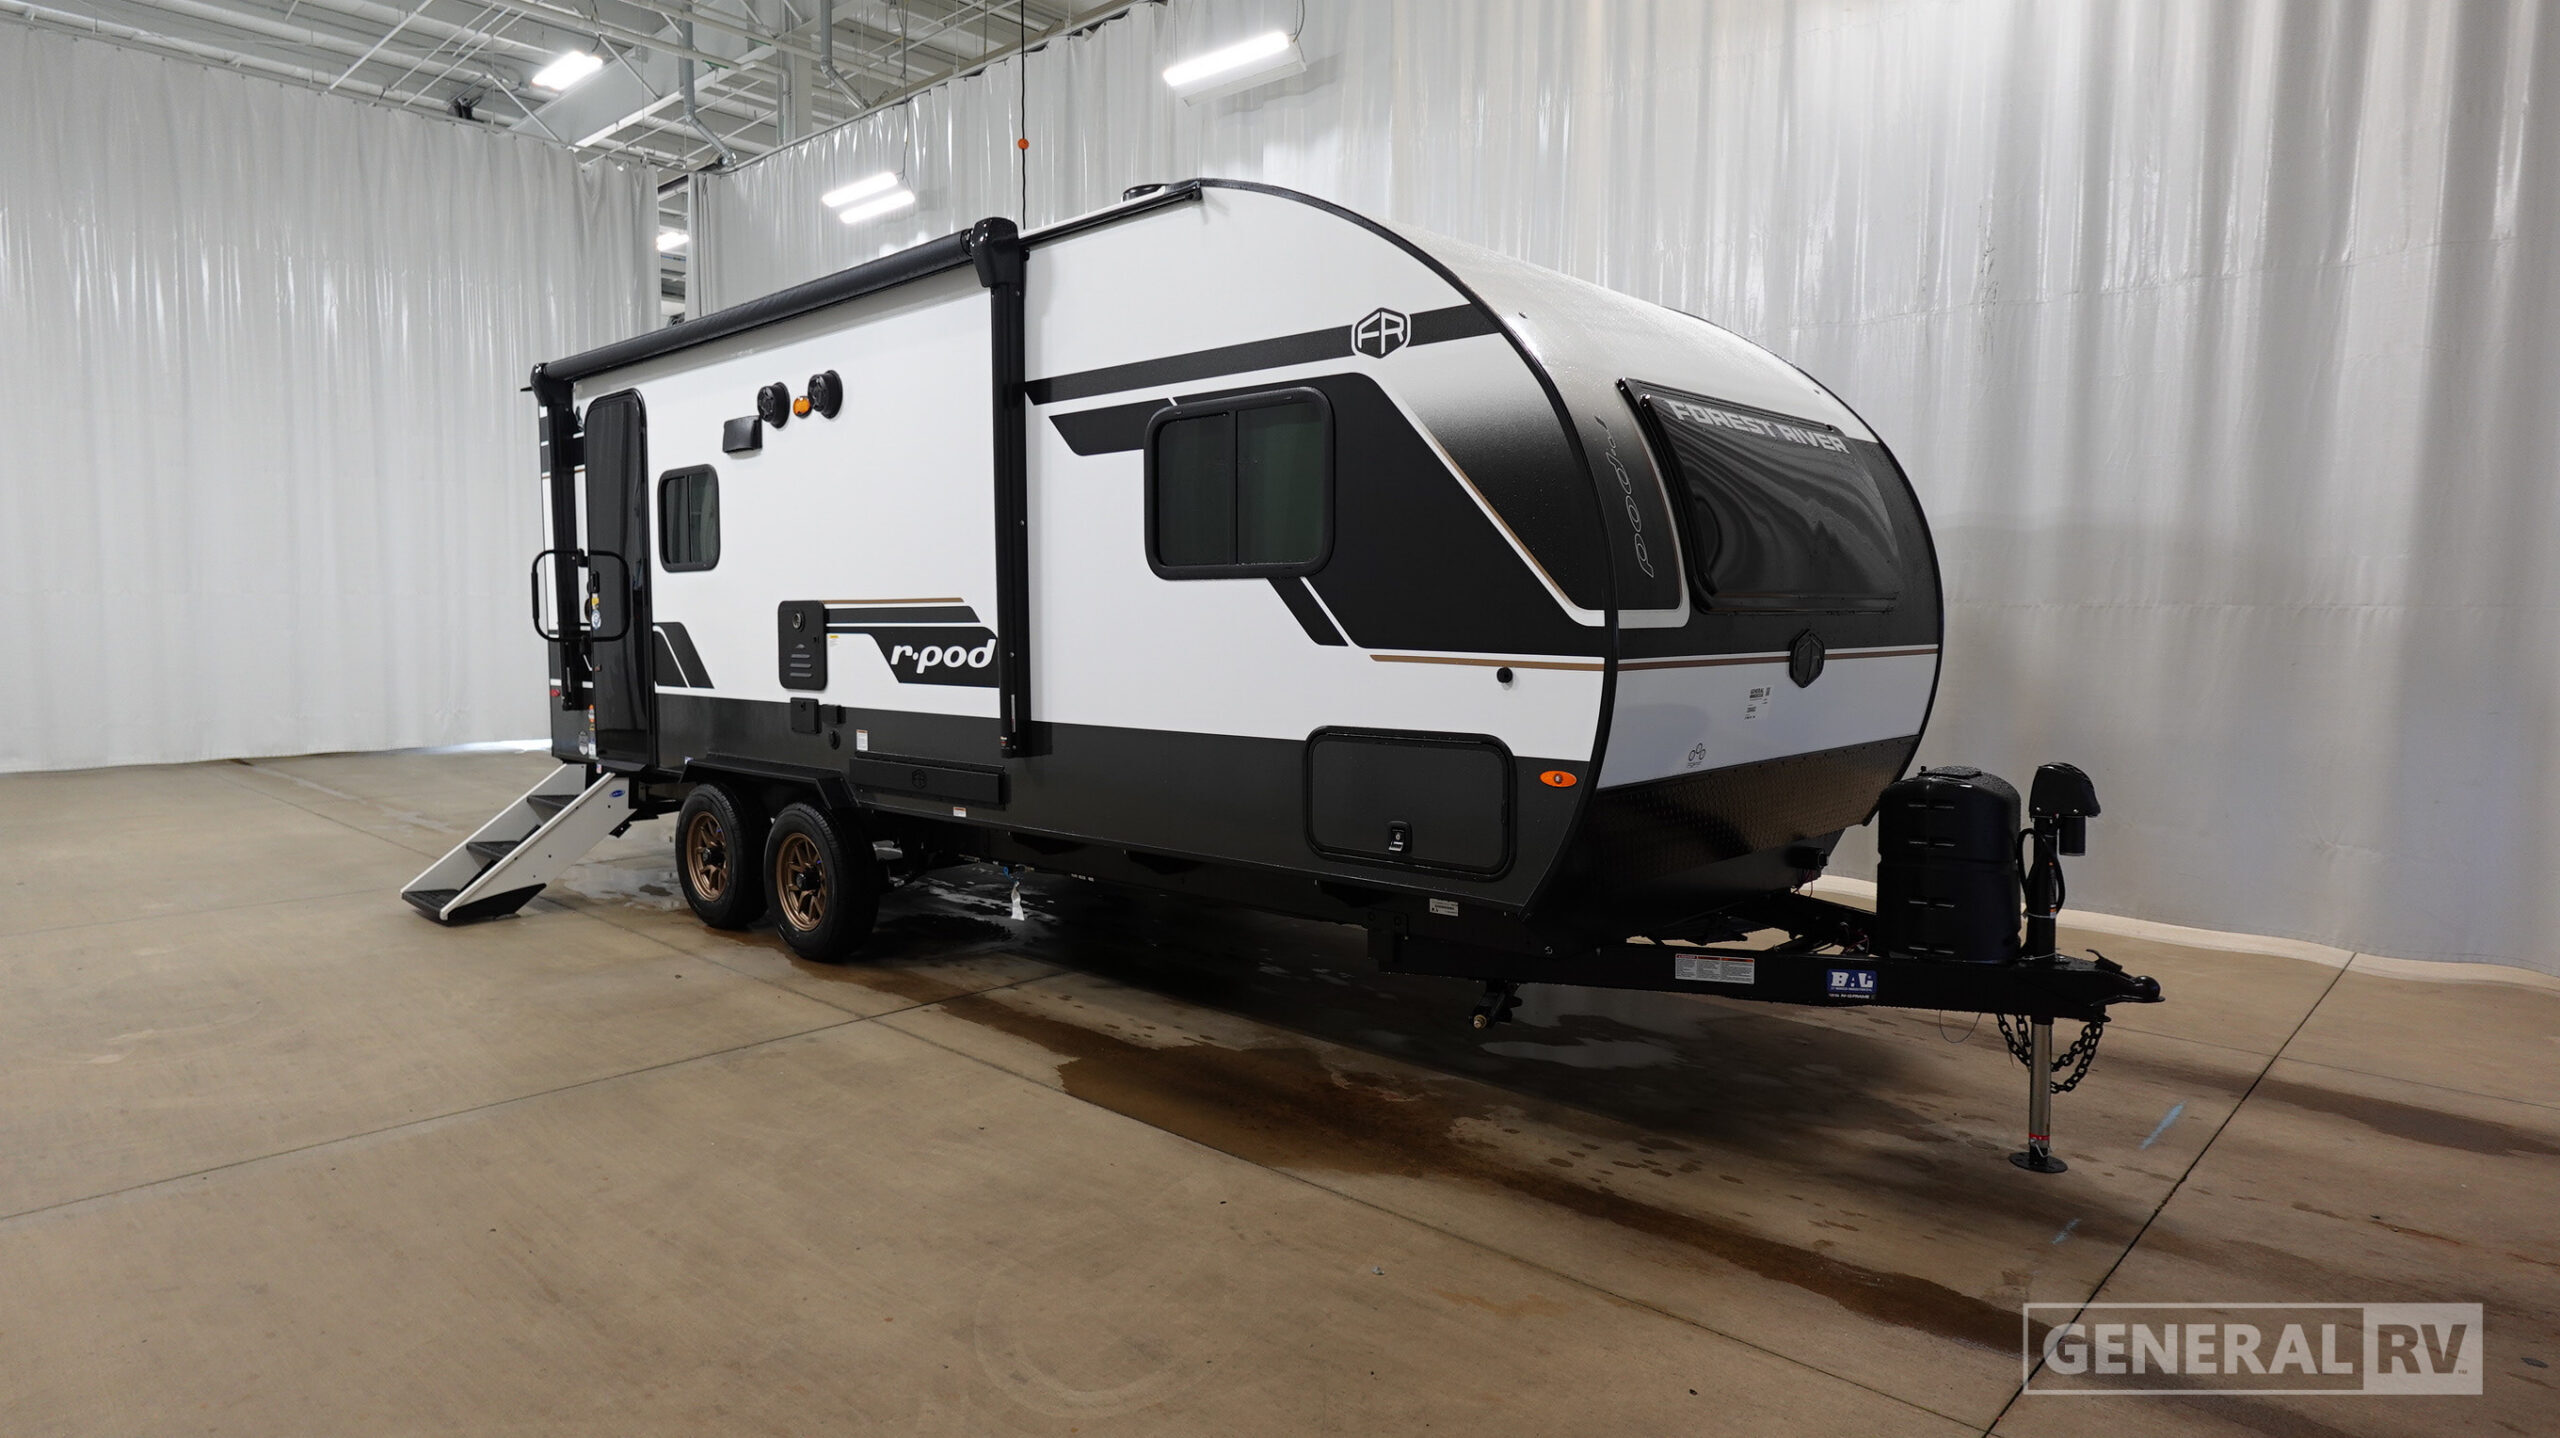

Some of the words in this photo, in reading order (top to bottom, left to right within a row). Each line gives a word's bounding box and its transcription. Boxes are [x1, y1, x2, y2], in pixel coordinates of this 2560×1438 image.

[1357, 311, 1405, 355] FR
[1664, 399, 1776, 438] FOREST
[1774, 423, 1850, 454] RIVER
[1831, 971, 1874, 988] BAL
